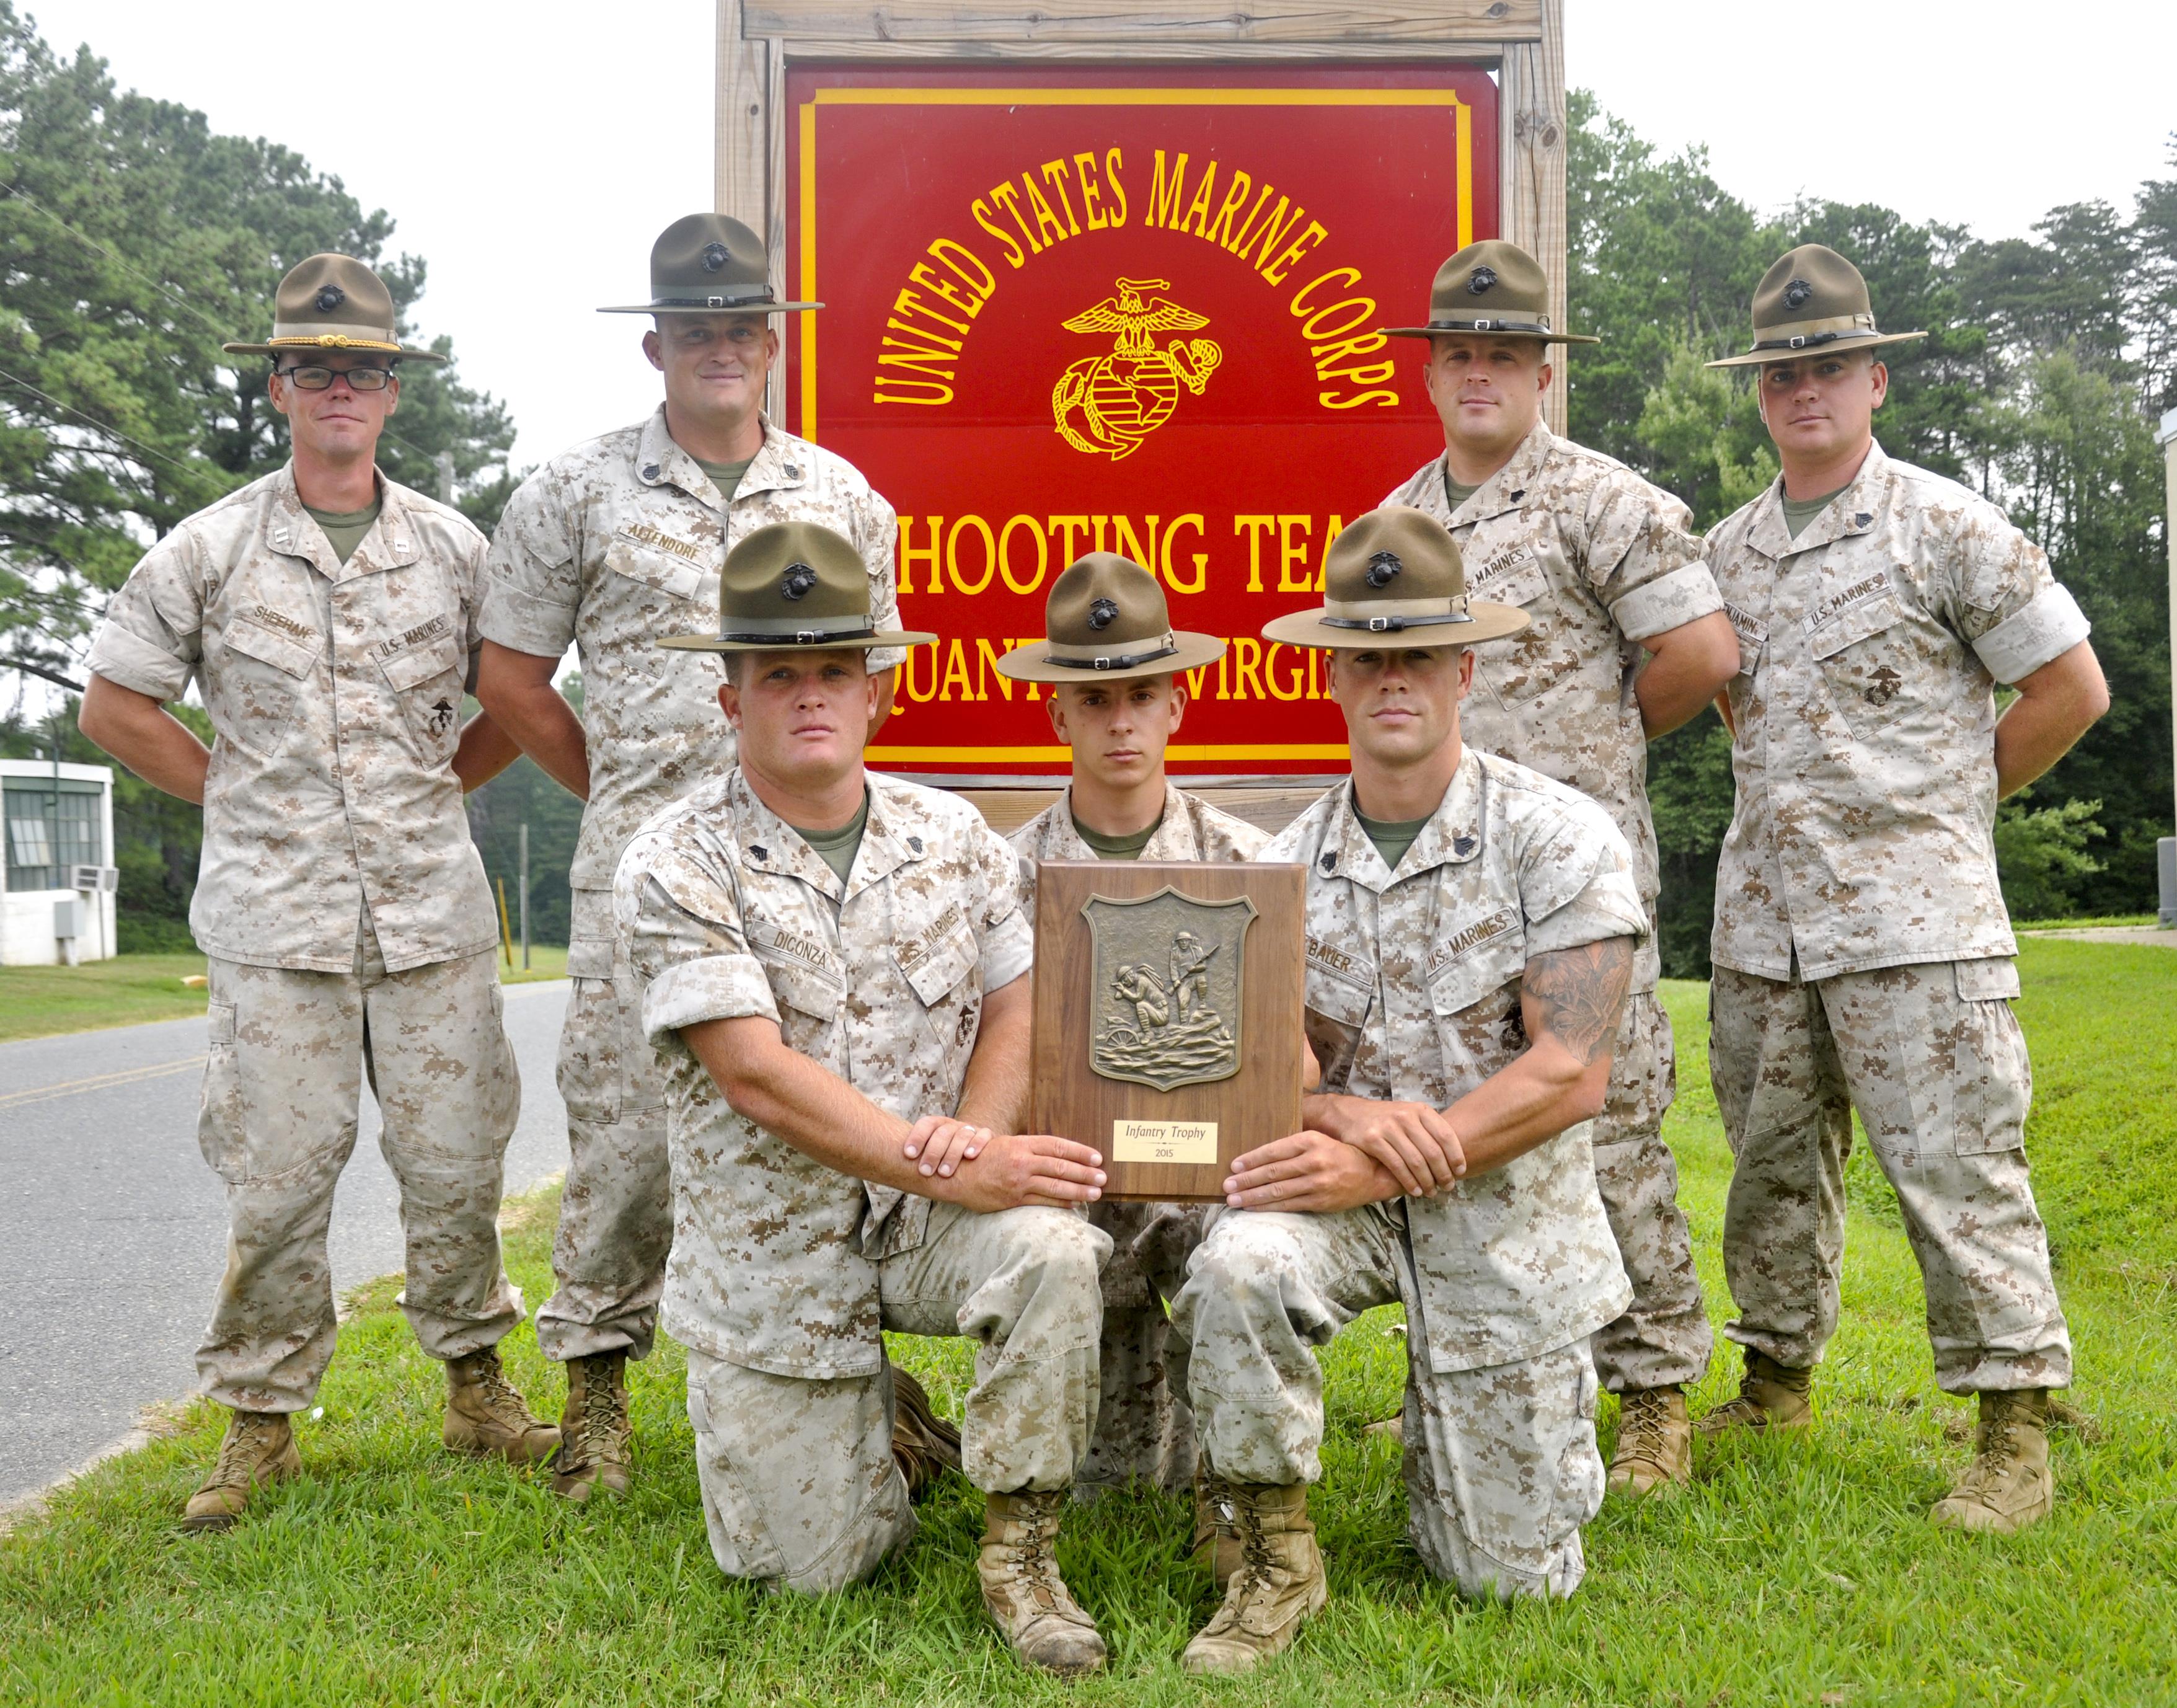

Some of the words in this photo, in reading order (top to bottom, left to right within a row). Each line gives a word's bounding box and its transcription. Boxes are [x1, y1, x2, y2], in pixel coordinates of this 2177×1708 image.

[873, 238, 996, 405] UNITED
[971, 148, 1127, 269] STATES
[1145, 149, 1328, 287] MARINE
[1290, 267, 1399, 409] CORPS
[896, 514, 1208, 595] HOOTING
[1234, 515, 1364, 592] TEA
[1475, 549, 1530, 585] MARINES
[1725, 604, 1757, 634] NJAMIN
[1811, 606, 1833, 626] U.S.
[1831, 574, 1884, 611] MARINES
[379, 639, 402, 657] U.S.
[404, 617, 444, 646] MARINES
[1186, 637, 1333, 701] VIRGI
[921, 907, 959, 947] MARINES
[1428, 949, 1449, 970] U.S.
[1448, 914, 1508, 955] MARINES
[774, 931, 826, 968] DICONZA
[1126, 1125, 1166, 1139] Infantry
[1171, 1125, 1206, 1141] Trophy
[1155, 1148, 1174, 1157] 2015
